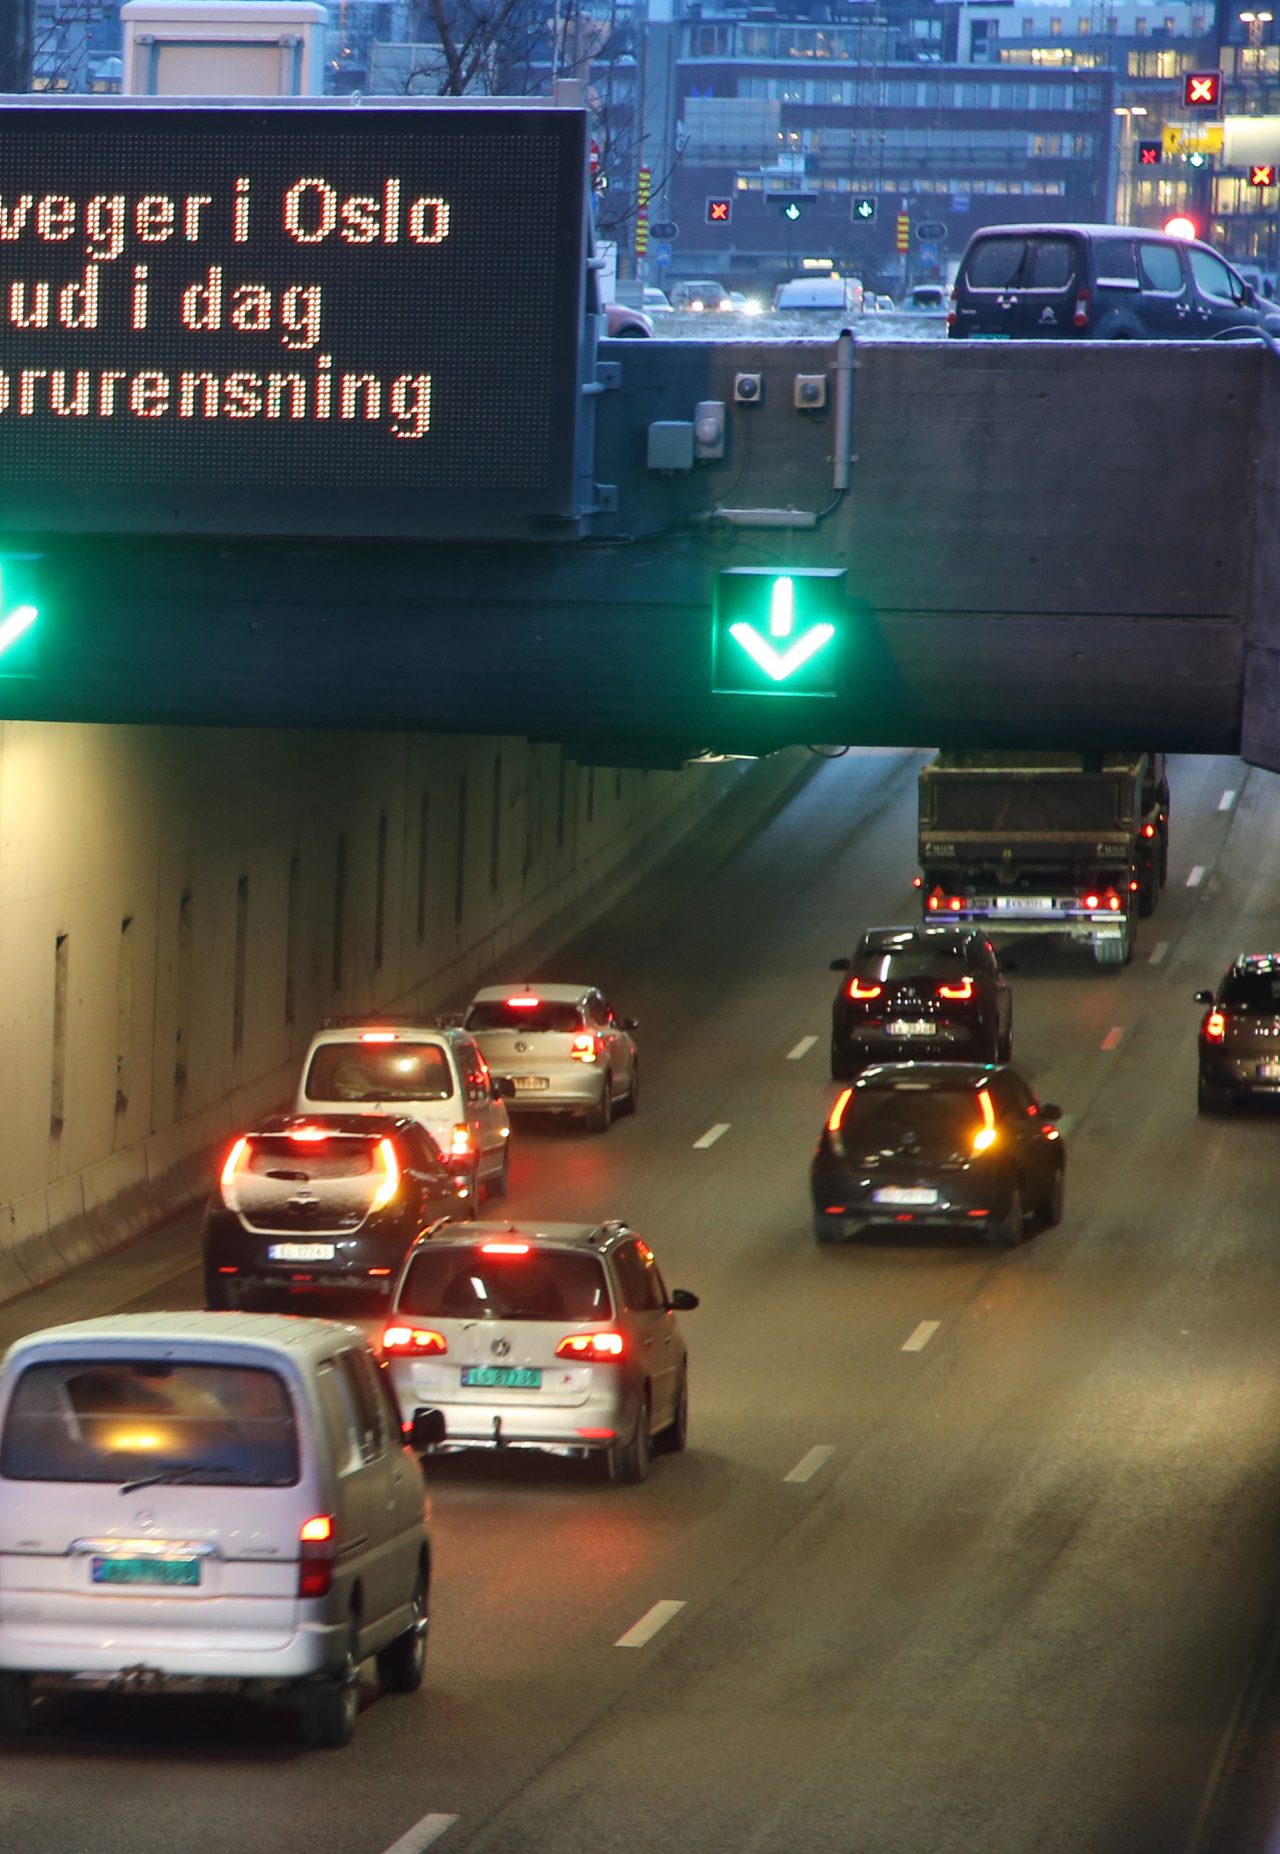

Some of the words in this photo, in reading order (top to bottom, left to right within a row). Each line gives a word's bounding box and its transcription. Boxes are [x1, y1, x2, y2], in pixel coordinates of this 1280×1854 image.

[234, 178, 250, 243] i
[283, 178, 451, 244] Oslo
[132, 265, 148, 330] i
[182, 266, 322, 350] dag
